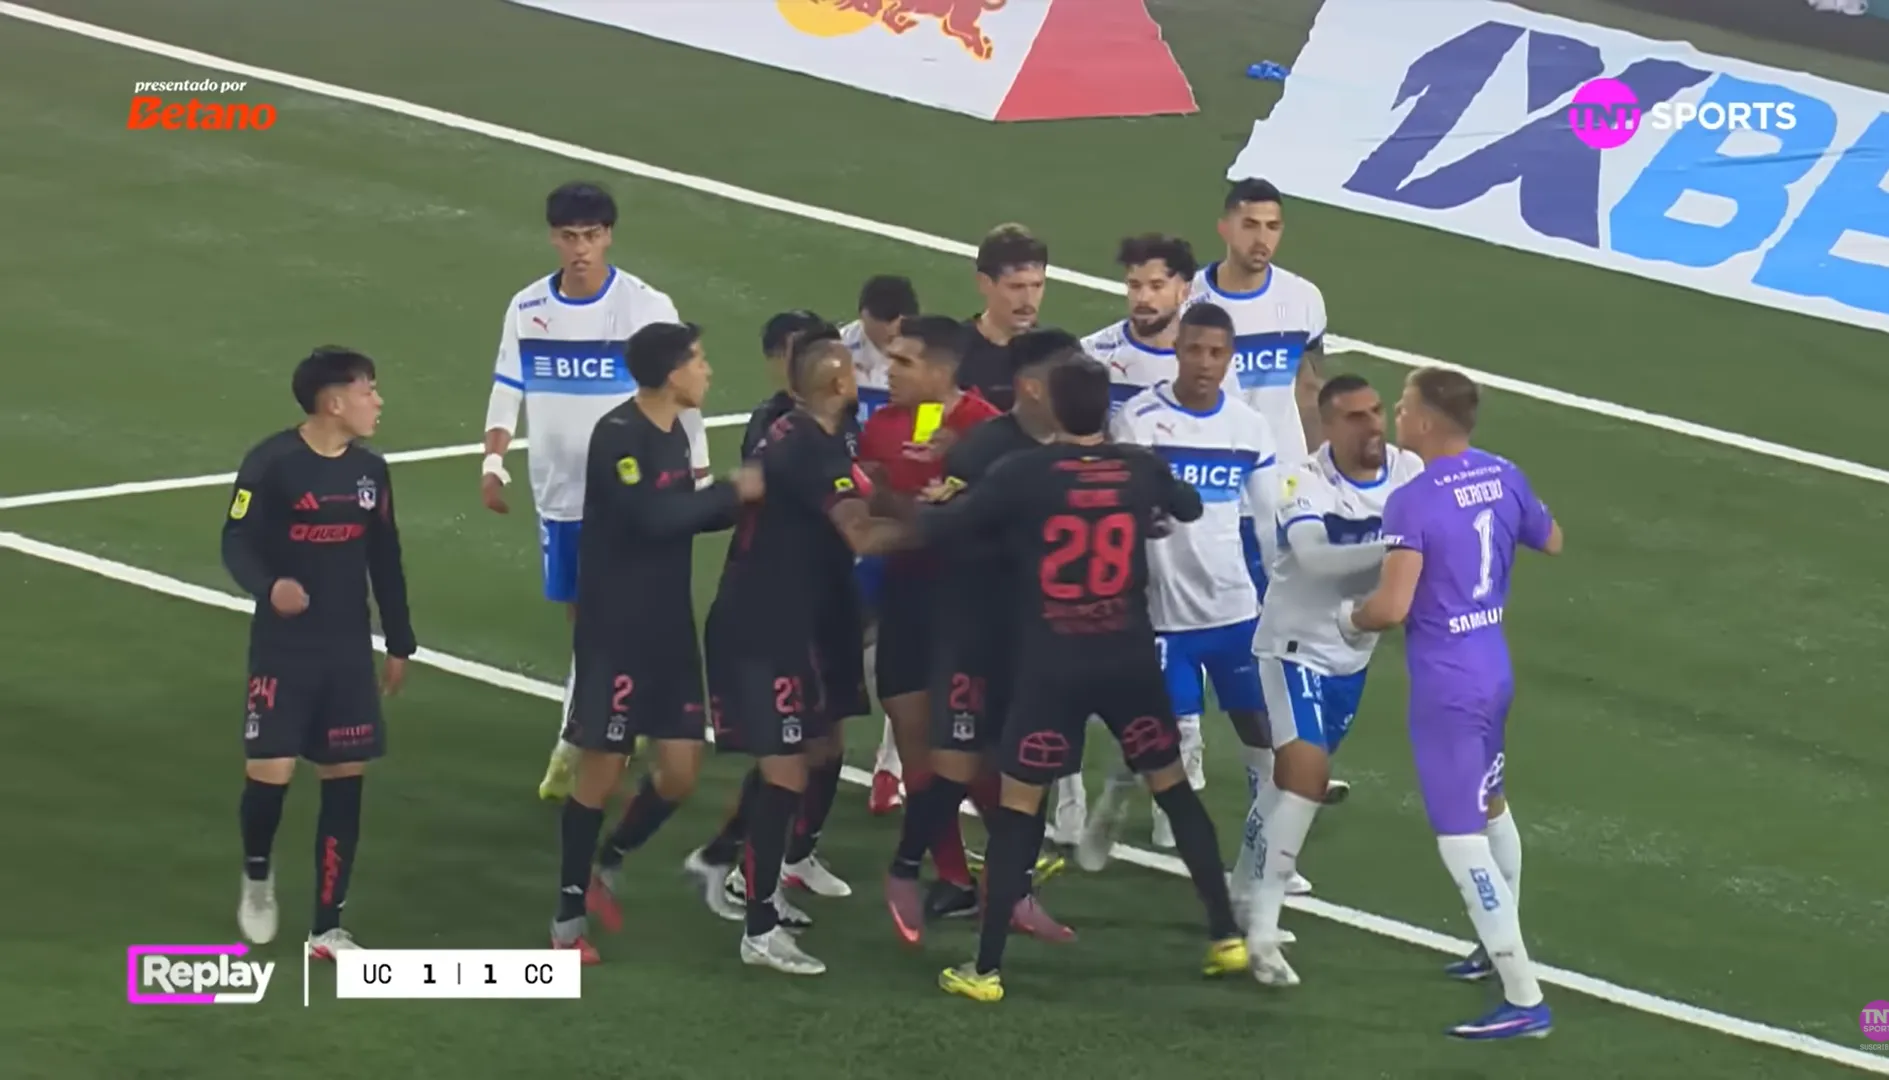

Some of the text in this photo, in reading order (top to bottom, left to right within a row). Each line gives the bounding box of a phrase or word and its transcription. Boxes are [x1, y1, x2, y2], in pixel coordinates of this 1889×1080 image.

[556, 358, 615, 378] BICE
[1183, 466, 1242, 487] BICE
[1041, 513, 1136, 599] 28
[1473, 508, 1494, 600] 1
[248, 676, 277, 711] 24
[612, 674, 634, 712] 2
